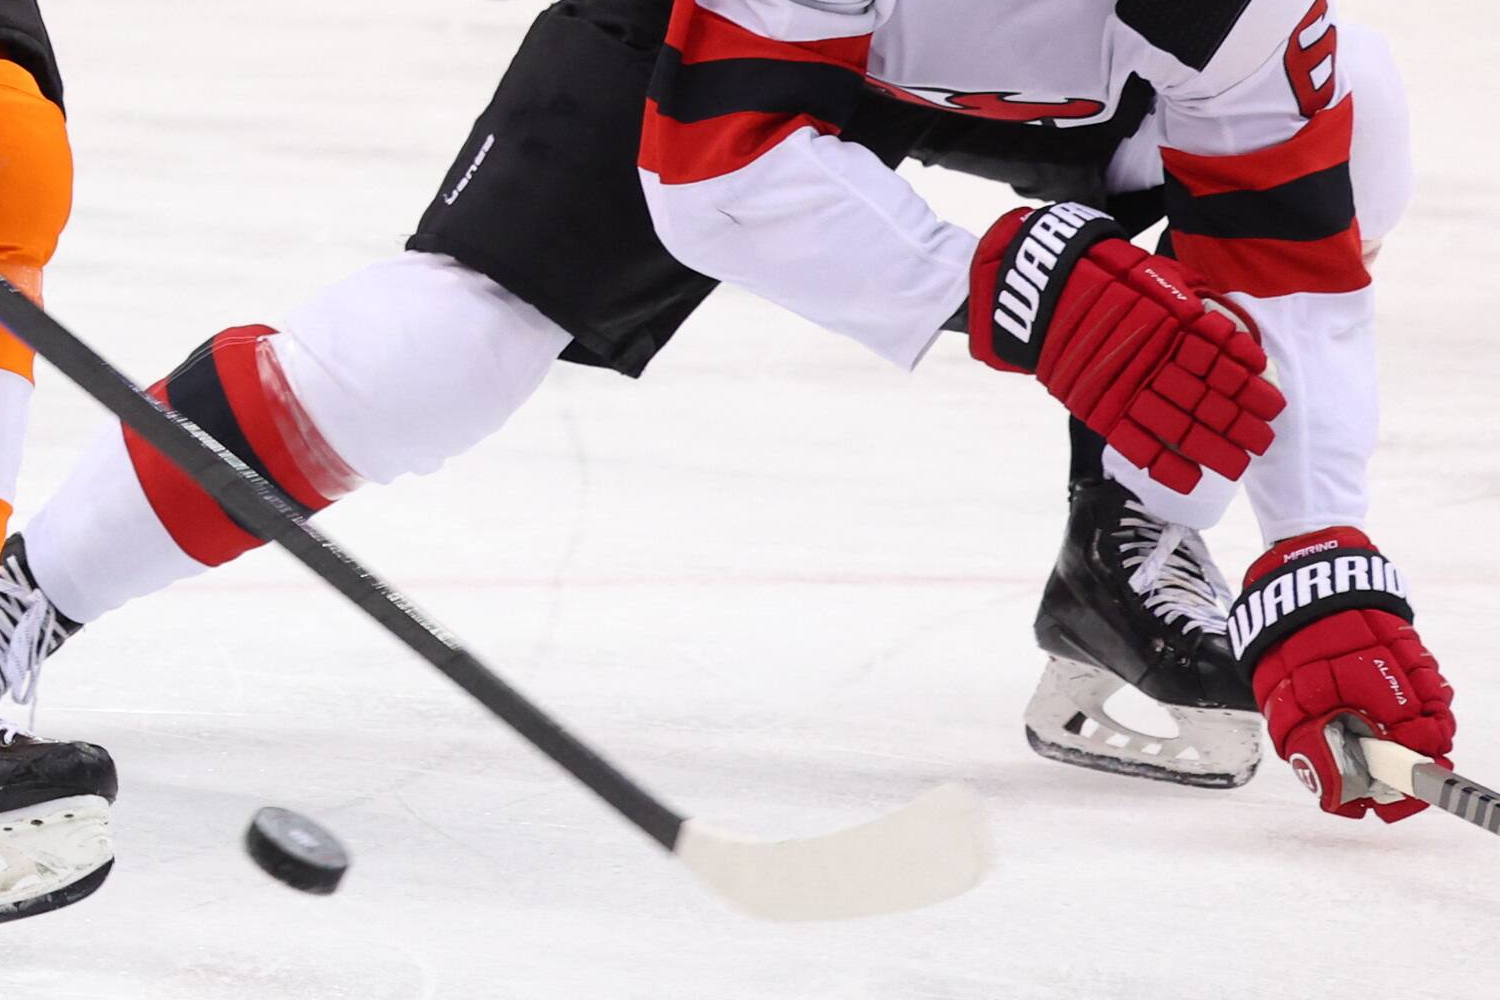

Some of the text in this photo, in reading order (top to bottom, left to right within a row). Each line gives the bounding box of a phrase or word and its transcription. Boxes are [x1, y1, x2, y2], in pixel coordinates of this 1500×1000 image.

[994, 202, 1114, 344] WARRI
[1283, 540, 1338, 563] MARINO
[1228, 555, 1407, 661] WARRIO
[1373, 658, 1409, 706] ALPHA
